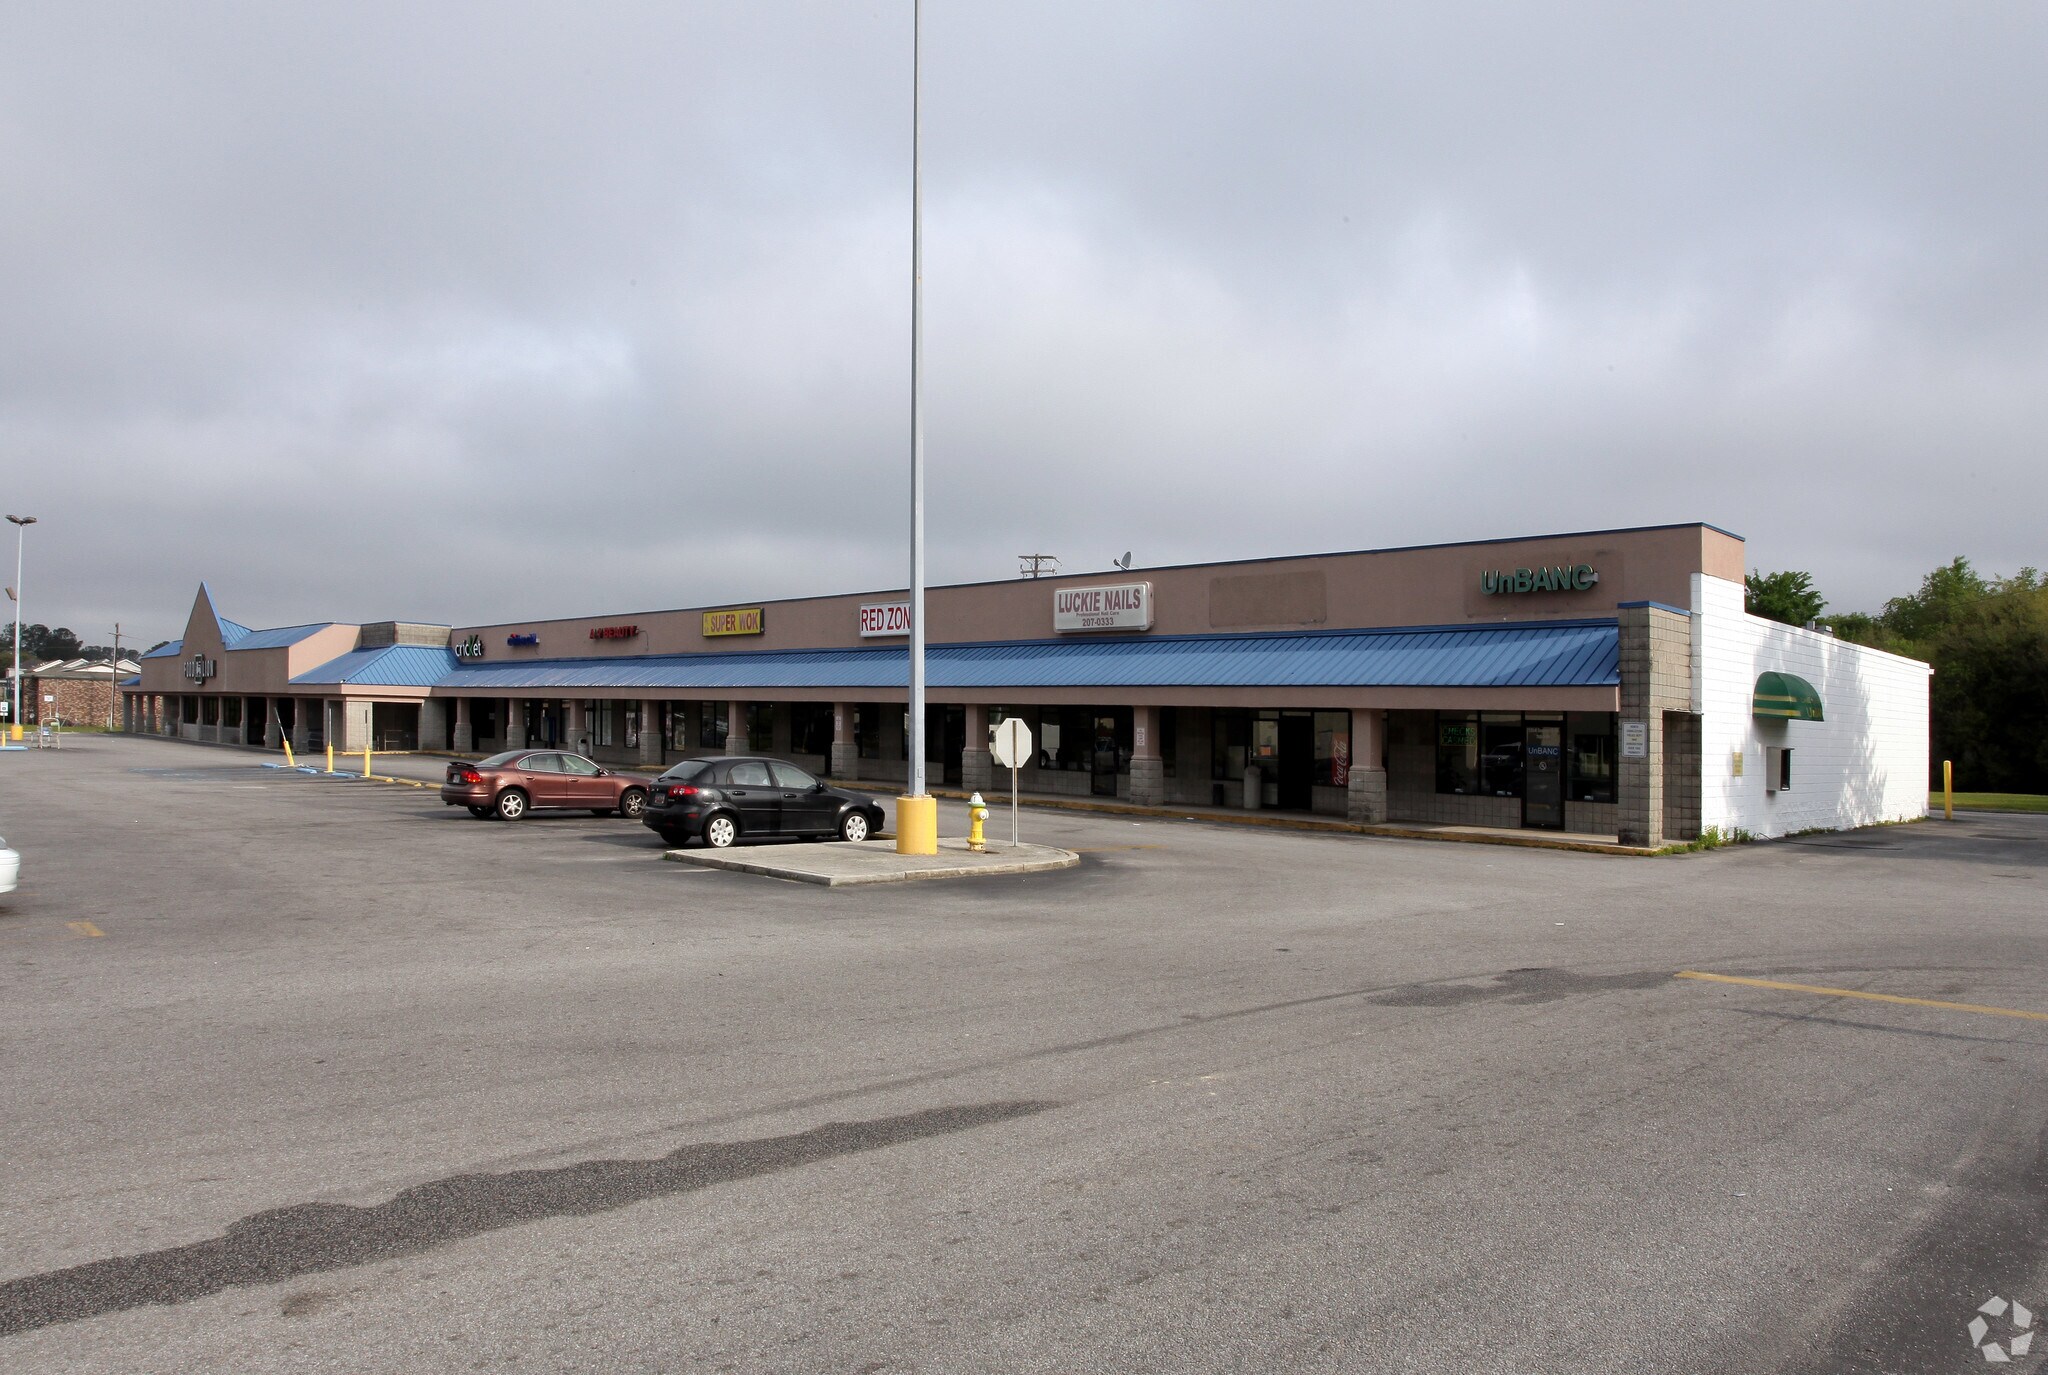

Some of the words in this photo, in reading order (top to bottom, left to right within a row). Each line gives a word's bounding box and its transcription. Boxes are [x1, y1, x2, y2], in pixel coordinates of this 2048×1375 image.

[1480, 564, 1594, 595] UnBANC
[1059, 591, 1100, 613] LUCKIE
[1105, 588, 1141, 611] NAILS
[711, 614, 736, 632] SUPER
[739, 612, 758, 630] WOK
[861, 608, 885, 631] RED
[887, 606, 910, 630] ZON
[1082, 617, 1114, 627] 207-0333
[1528, 747, 1559, 756] UnBANC
